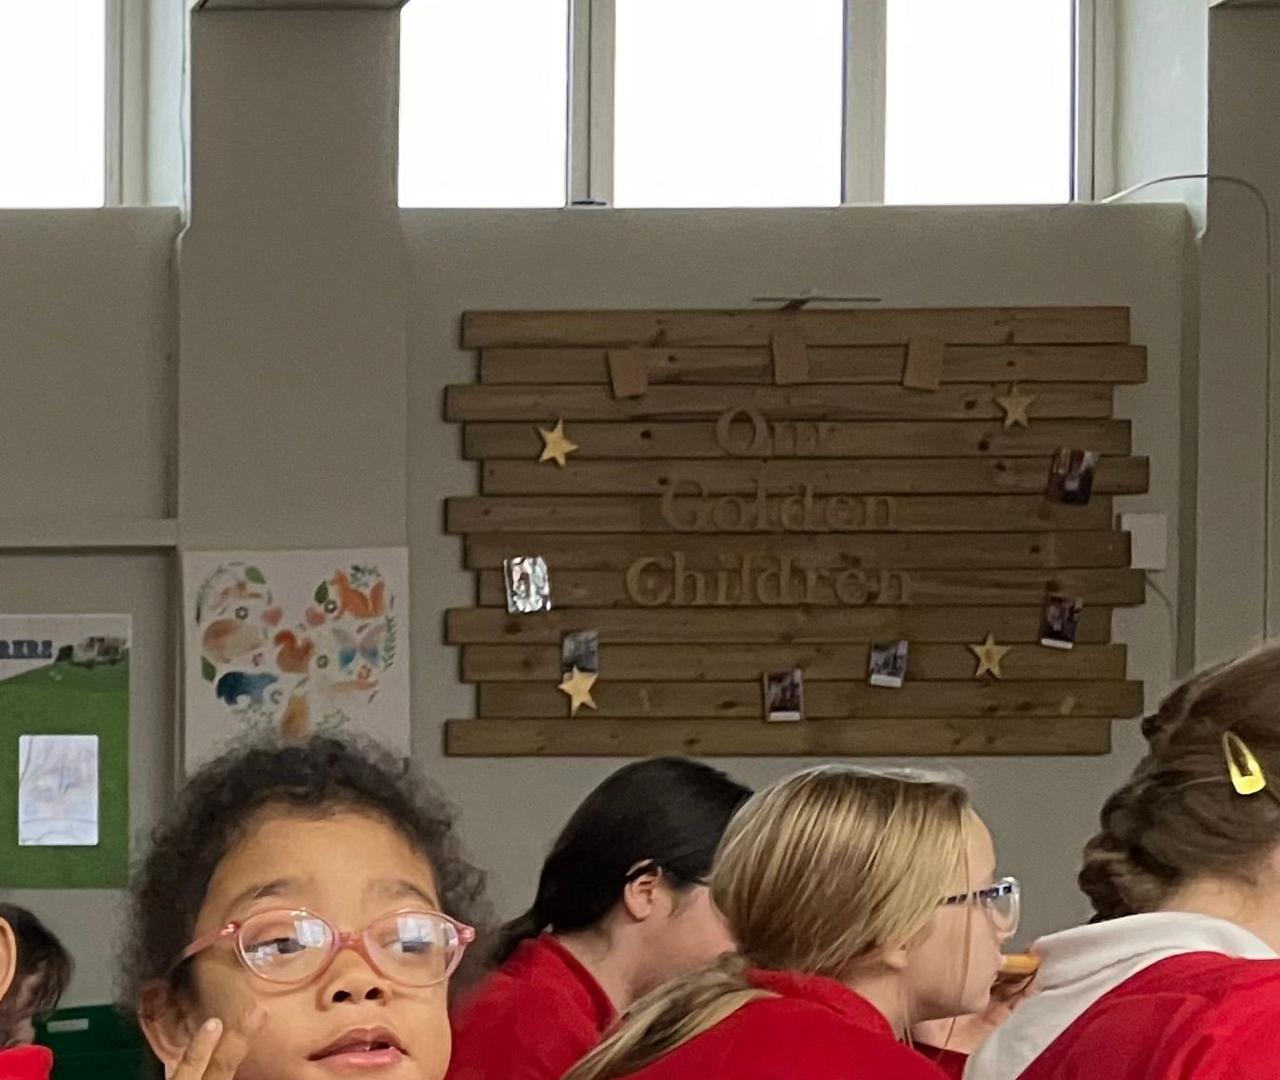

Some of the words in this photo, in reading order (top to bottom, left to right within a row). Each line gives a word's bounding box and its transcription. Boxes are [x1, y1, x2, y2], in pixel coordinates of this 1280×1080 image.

[716, 406, 837, 456] Our
[661, 479, 895, 530] Golden
[625, 551, 914, 605] Children
